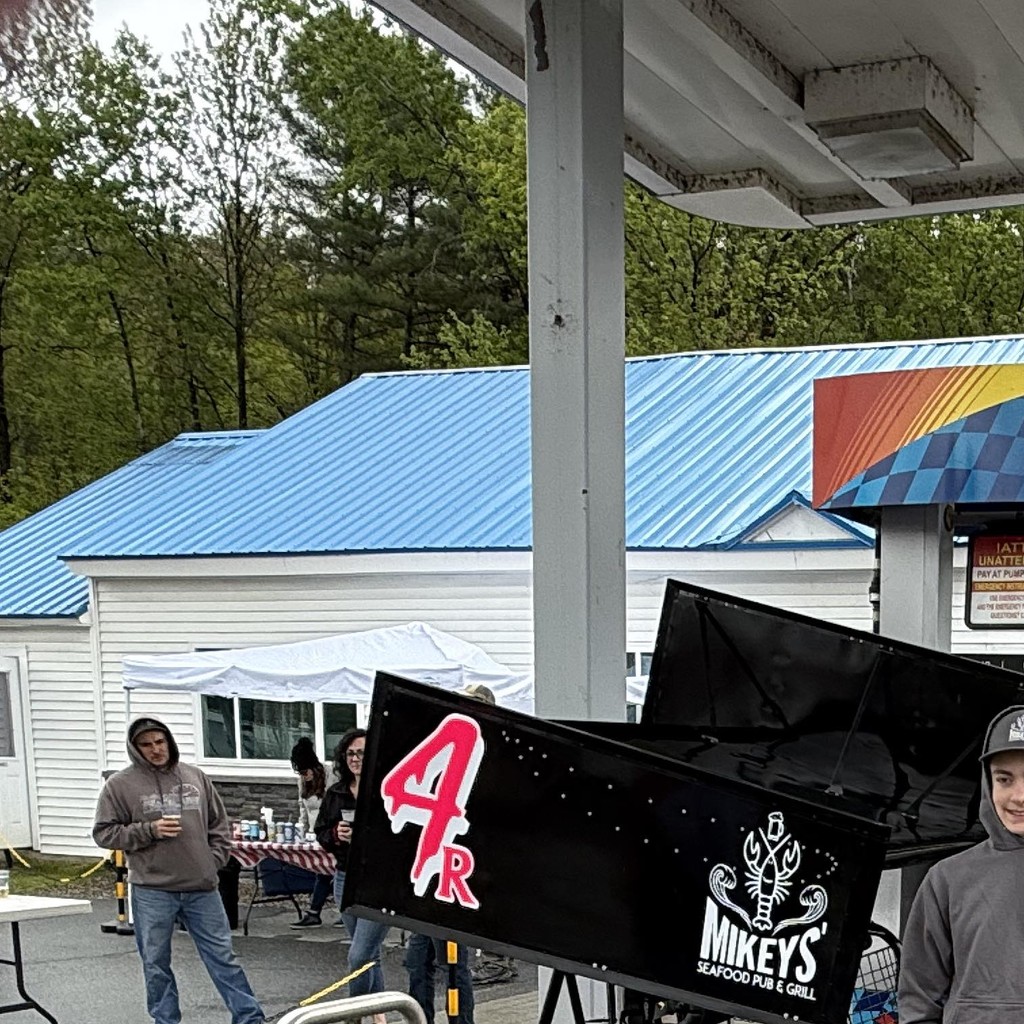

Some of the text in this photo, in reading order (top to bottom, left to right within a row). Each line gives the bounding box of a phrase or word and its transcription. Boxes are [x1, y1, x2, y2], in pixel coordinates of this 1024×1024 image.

[976, 570, 991, 579] PAY
[992, 570, 1001, 578] AT
[1003, 569, 1024, 578] PUMP
[700, 896, 828, 983] MIKEYS'
[696, 960, 817, 1001] SEAFOOD PUB & GRILL
